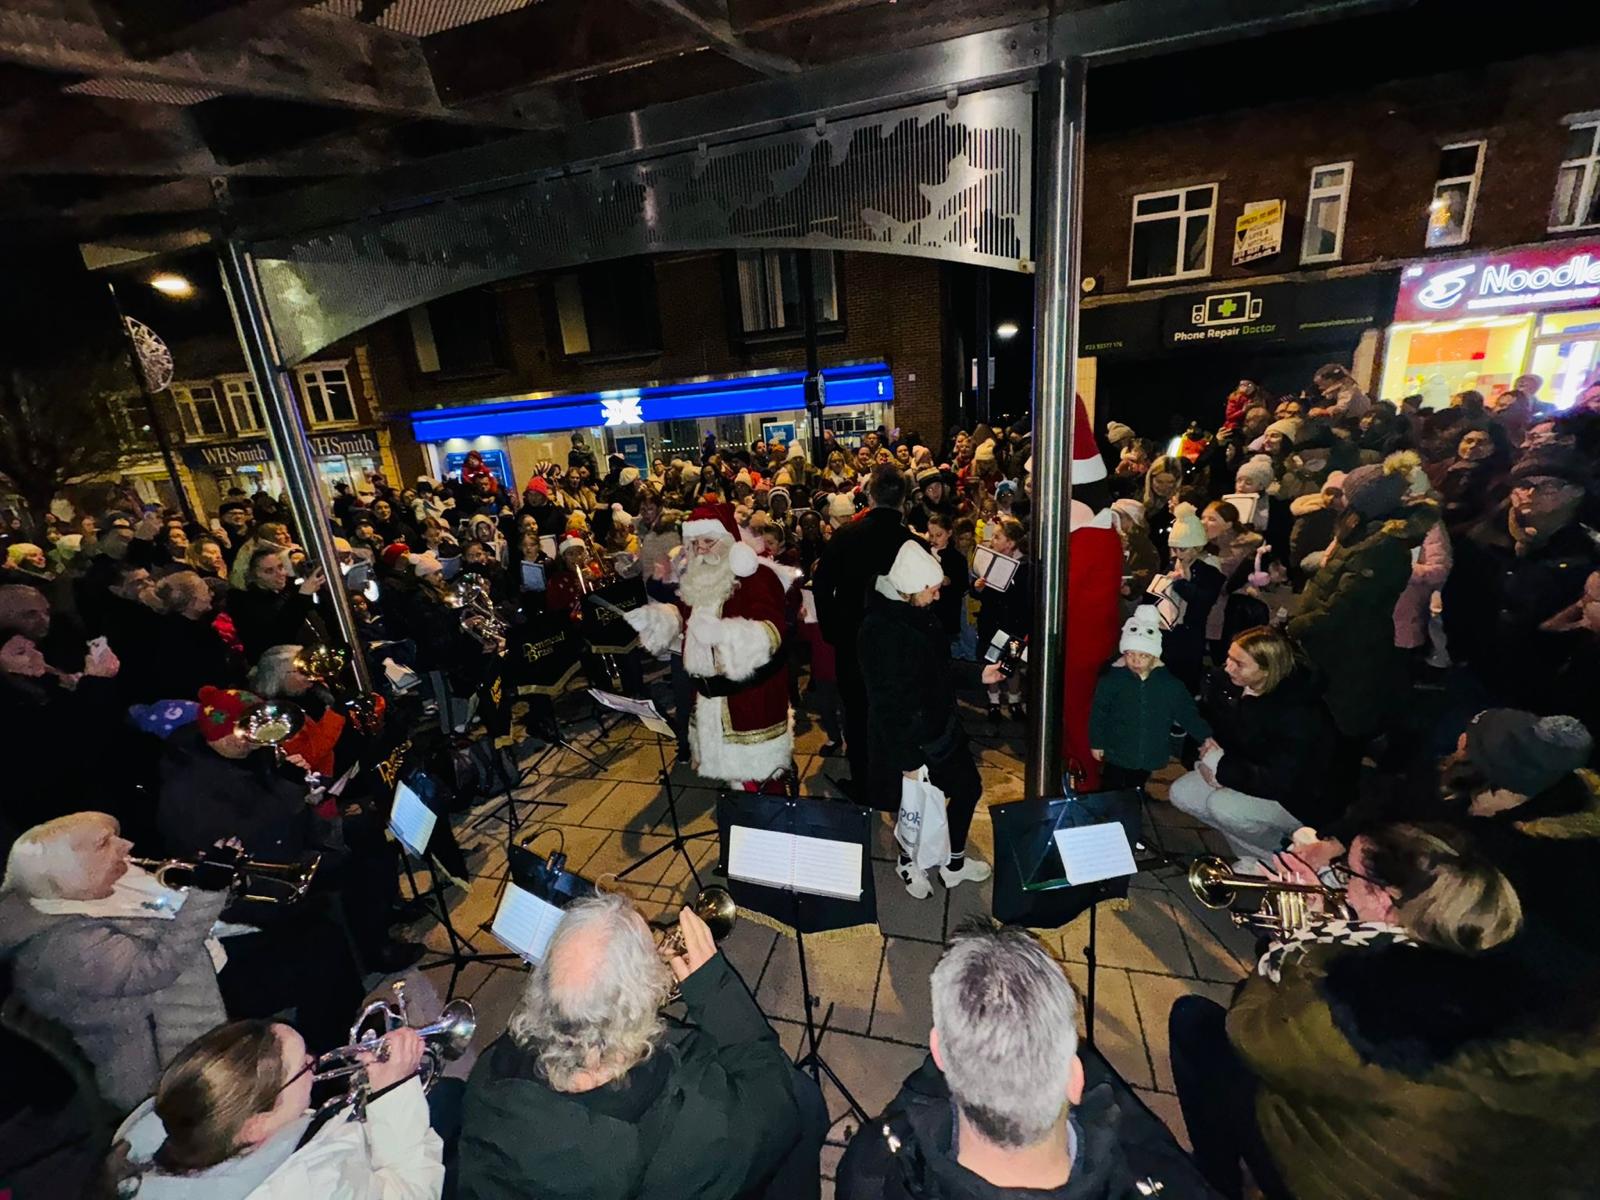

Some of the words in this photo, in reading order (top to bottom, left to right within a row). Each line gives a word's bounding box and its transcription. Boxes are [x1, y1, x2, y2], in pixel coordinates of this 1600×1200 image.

[1174, 331, 1205, 341] Phone
[1207, 327, 1240, 339] Repair
[1242, 324, 1276, 335] Doctor
[201, 444, 268, 465] WHSmith
